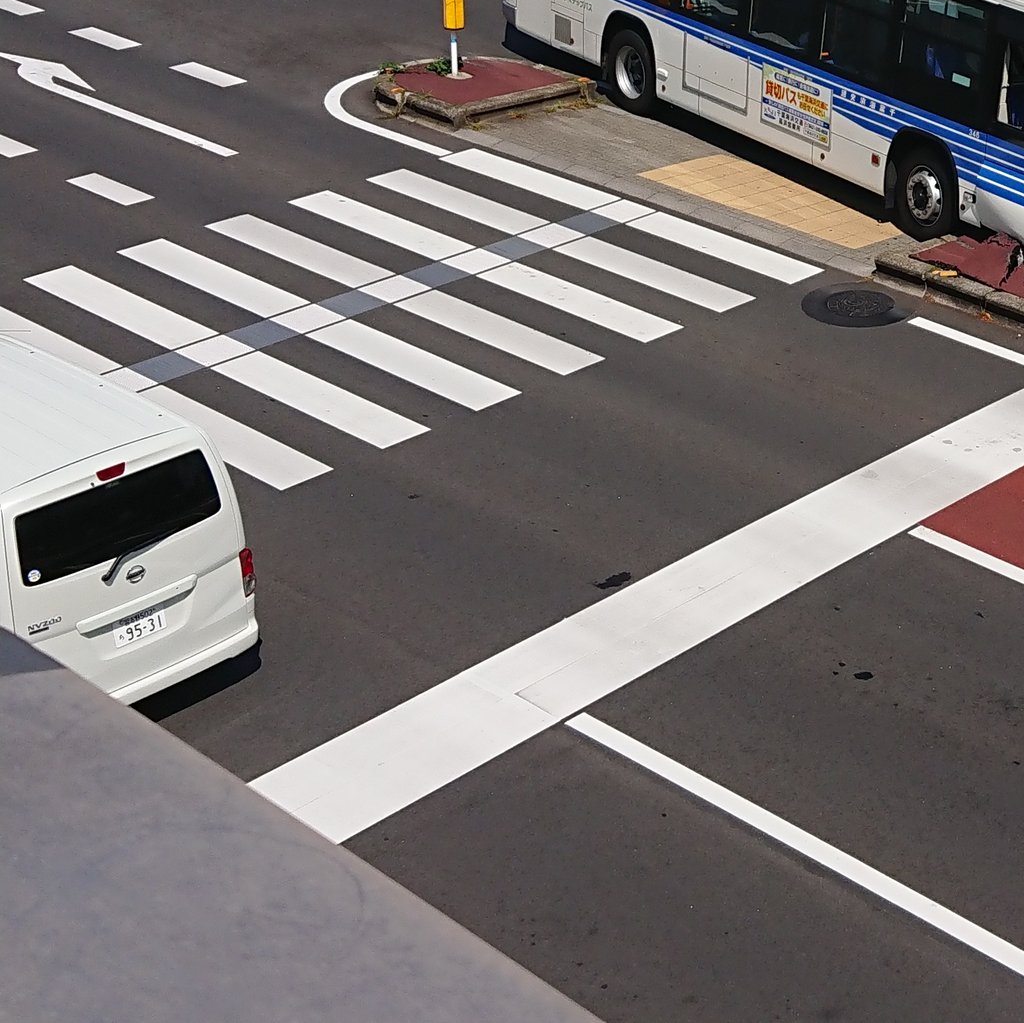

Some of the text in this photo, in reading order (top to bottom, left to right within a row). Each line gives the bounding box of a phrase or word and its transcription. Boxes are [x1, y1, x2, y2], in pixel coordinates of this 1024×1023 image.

[765, 80, 797, 106] 貸切バス
[126, 614, 162, 641] 95-31
